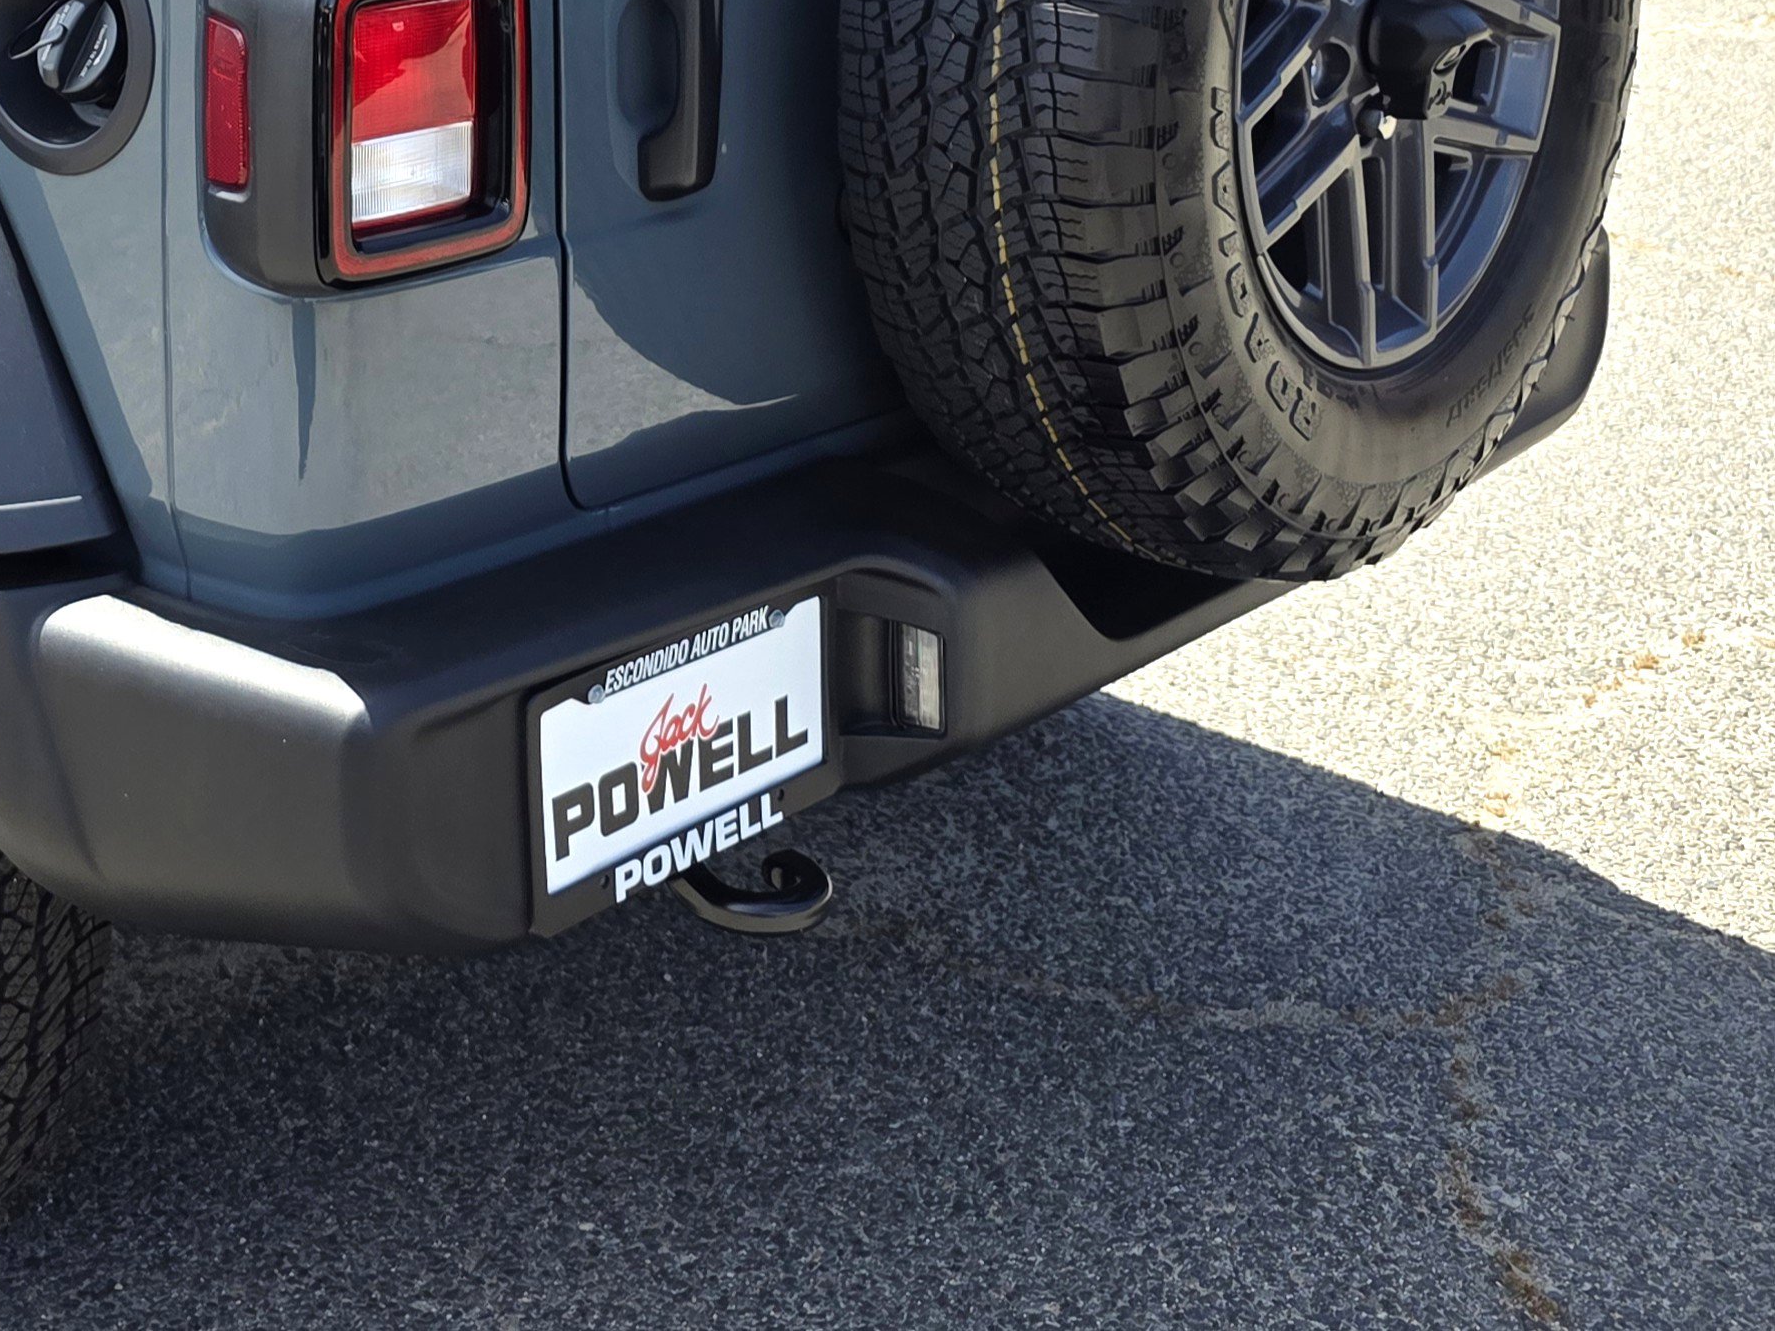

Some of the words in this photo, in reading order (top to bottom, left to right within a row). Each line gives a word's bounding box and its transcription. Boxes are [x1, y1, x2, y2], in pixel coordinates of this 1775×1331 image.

[604, 636, 691, 694] ESCONDIDO
[690, 622, 729, 660] AUTO
[730, 605, 770, 645] PARK
[552, 694, 809, 861] POWELL
[639, 683, 720, 794] Jack
[614, 792, 784, 904] POWELL
